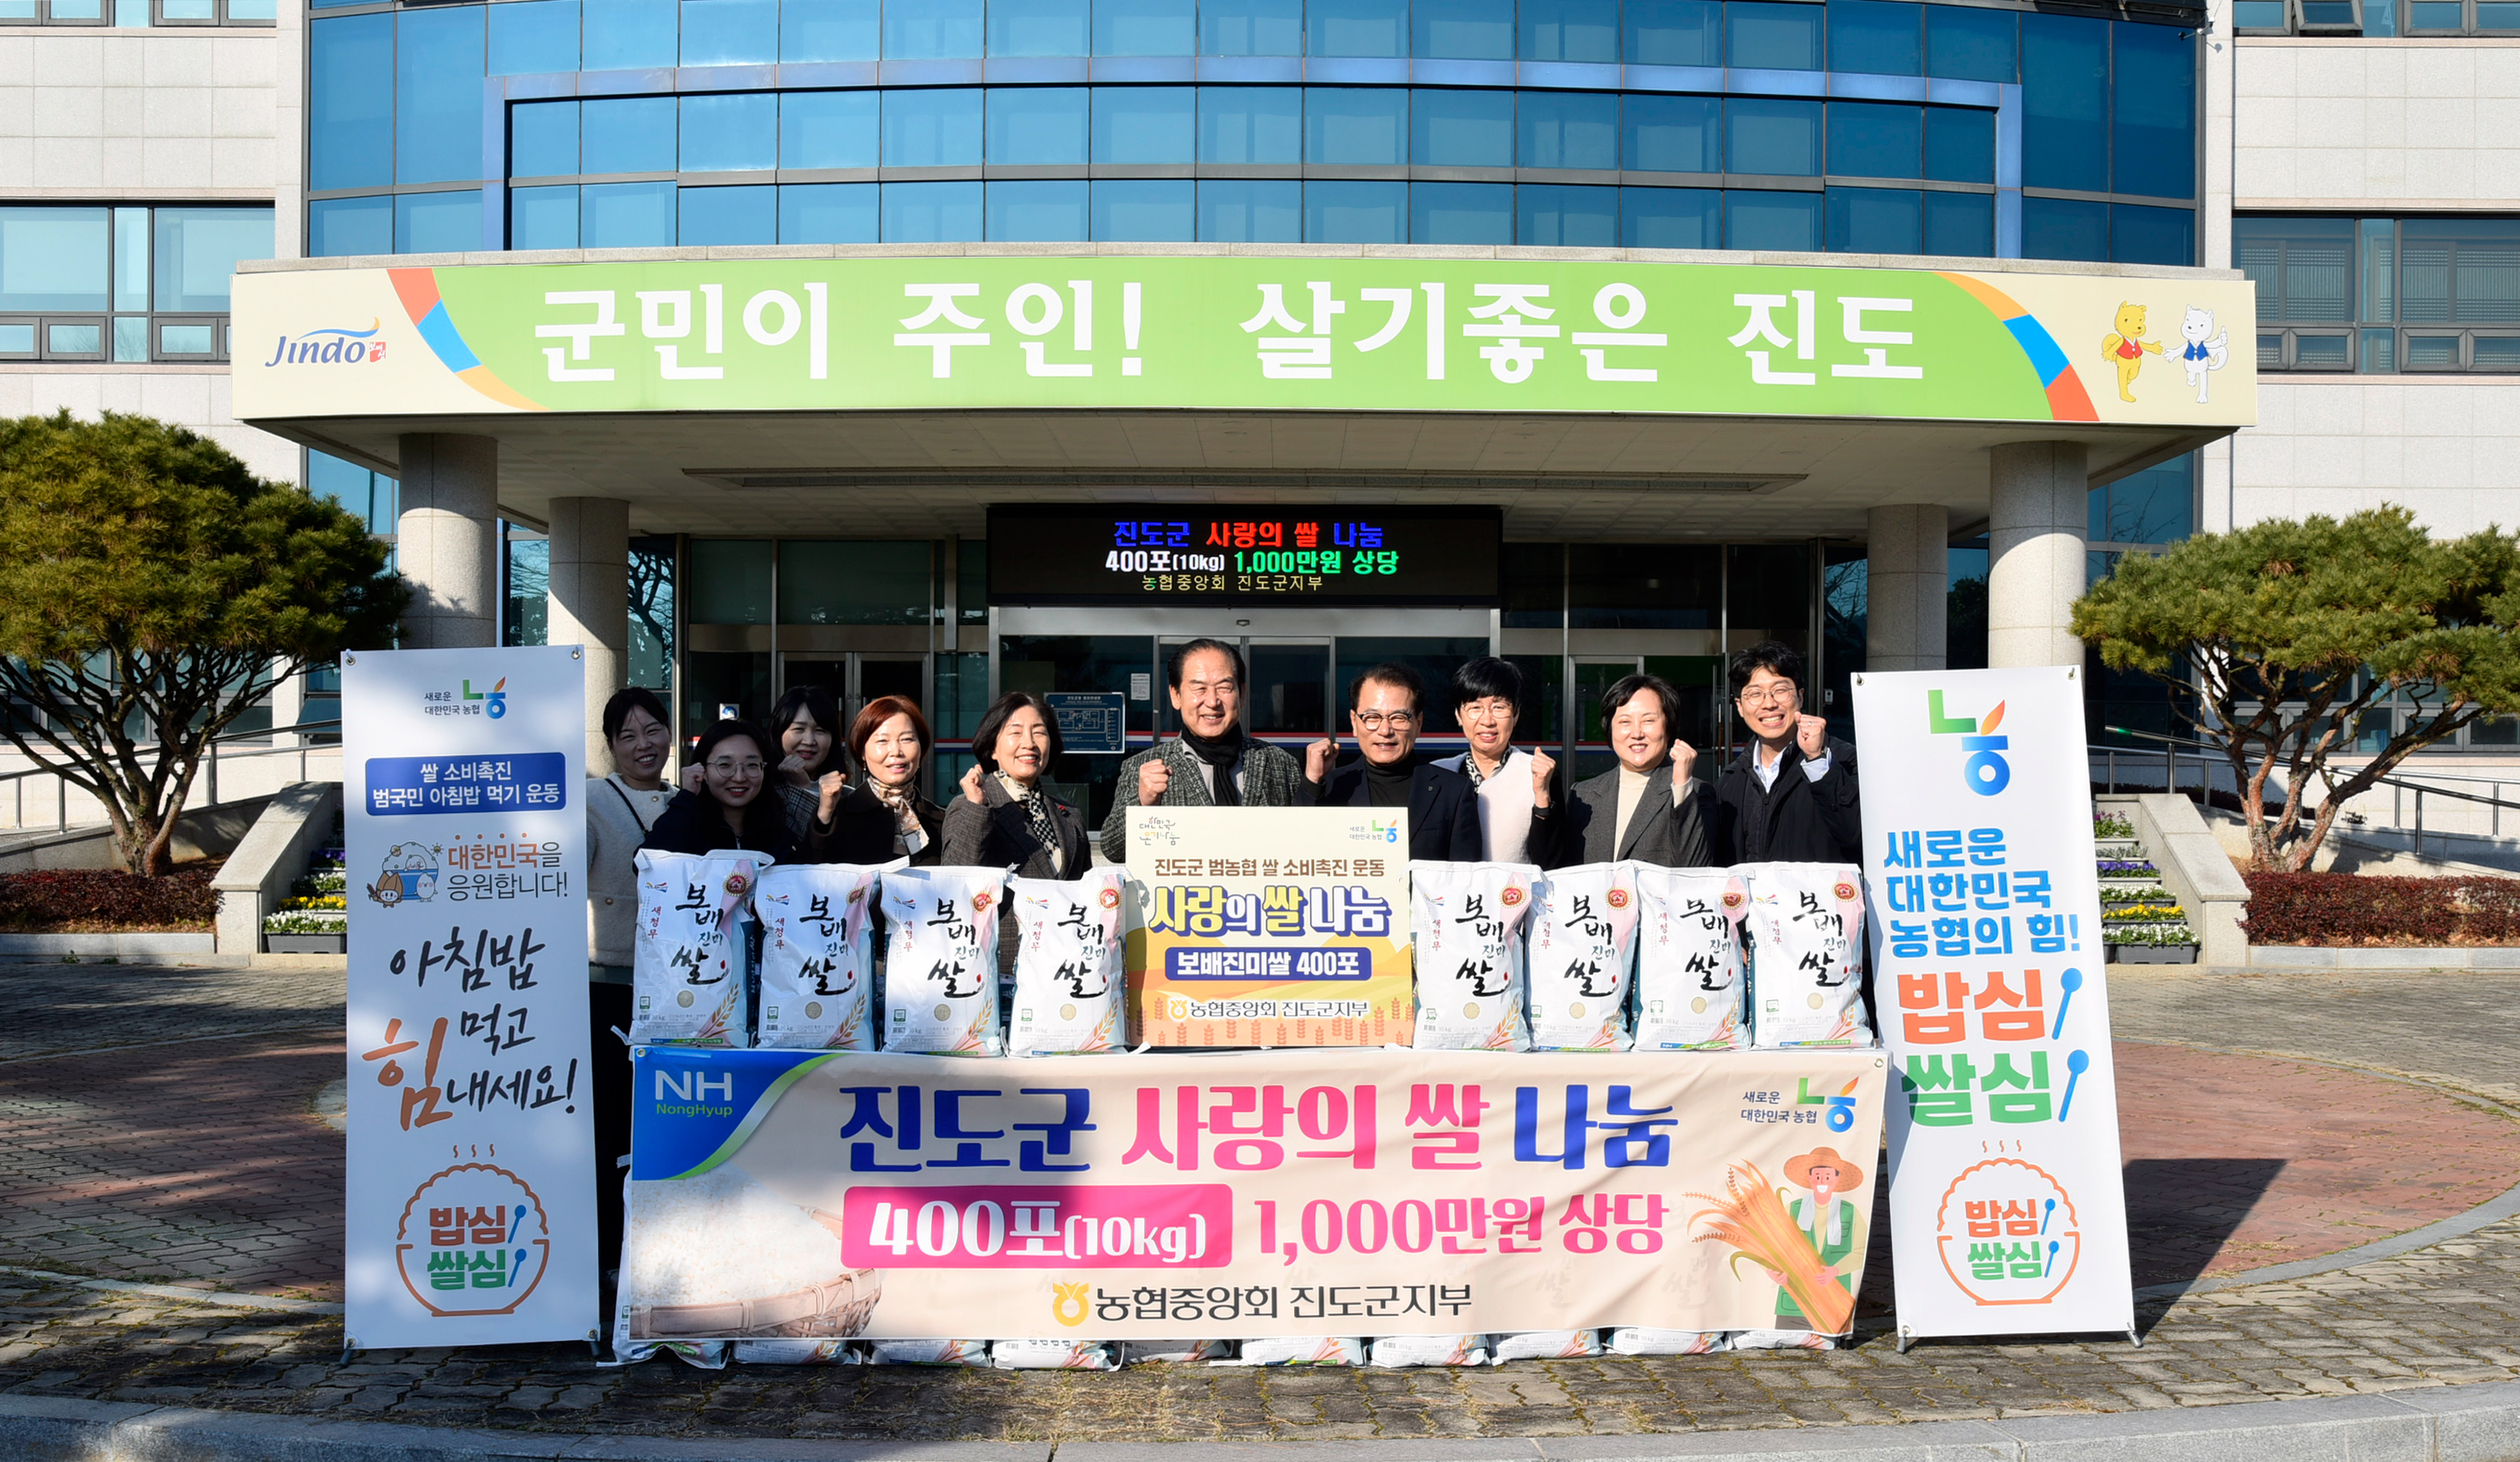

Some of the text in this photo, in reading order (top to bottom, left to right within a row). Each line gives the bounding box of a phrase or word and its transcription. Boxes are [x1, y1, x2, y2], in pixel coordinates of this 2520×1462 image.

[535, 280, 1923, 386] 군민이 주인! 살기좋은 진도
[264, 335, 366, 368] Jindo
[1113, 521, 1383, 548] 진도군 사랑의 쌀 나눔
[1105, 550, 1399, 574] 400포(10kg) 1,000만원 상당
[1141, 574, 1323, 591] 농협중앙회 진도군지부
[424, 691, 452, 701] 새로운
[424, 704, 481, 715] 대한민국 농협
[420, 761, 512, 782] 쌀 소비촉진
[373, 783, 561, 809] 범국민 아침밥 먹기 운동
[447, 841, 563, 870] 대한민국을
[1883, 828, 2007, 869] 새로운
[1154, 858, 1385, 877] 진도군 범농협 쌀 소비촉진 운동
[447, 872, 568, 901] 응원합니다!
[1886, 870, 2052, 913] 대한민국
[1149, 885, 1261, 937] 사랑의
[1263, 885, 1307, 936] 쌀
[1310, 885, 1392, 936] 나눔
[698, 932, 723, 946] 진미
[825, 942, 848, 957] 진미
[954, 946, 979, 960] 진미
[1081, 946, 1106, 960] 진미
[1482, 944, 1506, 959] 진미
[1709, 939, 1731, 954] 진미
[1823, 938, 1846, 952] 진미
[1890, 914, 2081, 958] 농협의 힘!
[389, 926, 545, 993] 아침밥
[670, 945, 730, 986] 쌀
[1177, 951, 1360, 976] 보배진미쌀 400포
[1591, 946, 1615, 961] 진미
[1798, 951, 1851, 987] 쌀
[798, 956, 857, 996] 쌀
[928, 959, 985, 999] 쌀
[1054, 959, 1109, 999] 쌀
[1455, 958, 1511, 997] 쌀
[1563, 957, 1619, 997] 쌀
[1685, 951, 1734, 991] 쌀
[1190, 1001, 1368, 1018] 농협중앙회 진도군지부
[1897, 969, 2045, 1044] 밥심
[460, 1003, 536, 1056] 먹고
[362, 1017, 577, 1131] 힘 내세요!
[655, 1070, 732, 1102] NH
[1901, 1050, 2052, 1126] 쌀심
[656, 1104, 733, 1118] NongHyup
[1742, 1091, 1780, 1104] 새로운
[839, 1083, 1679, 1173] 진도군 사랑의 쌀 나눔
[1740, 1109, 1818, 1124] 대한민국 농협
[429, 1205, 505, 1246] 밥심
[869, 1193, 1669, 1266] 400포(10kg) 1,000만원 상당
[1965, 1198, 2038, 1238] 밥심
[427, 1249, 506, 1290] 쌀심
[1967, 1241, 2042, 1280] 쌀심
[1094, 1284, 1473, 1321] 농협중앙회 진도군지부
